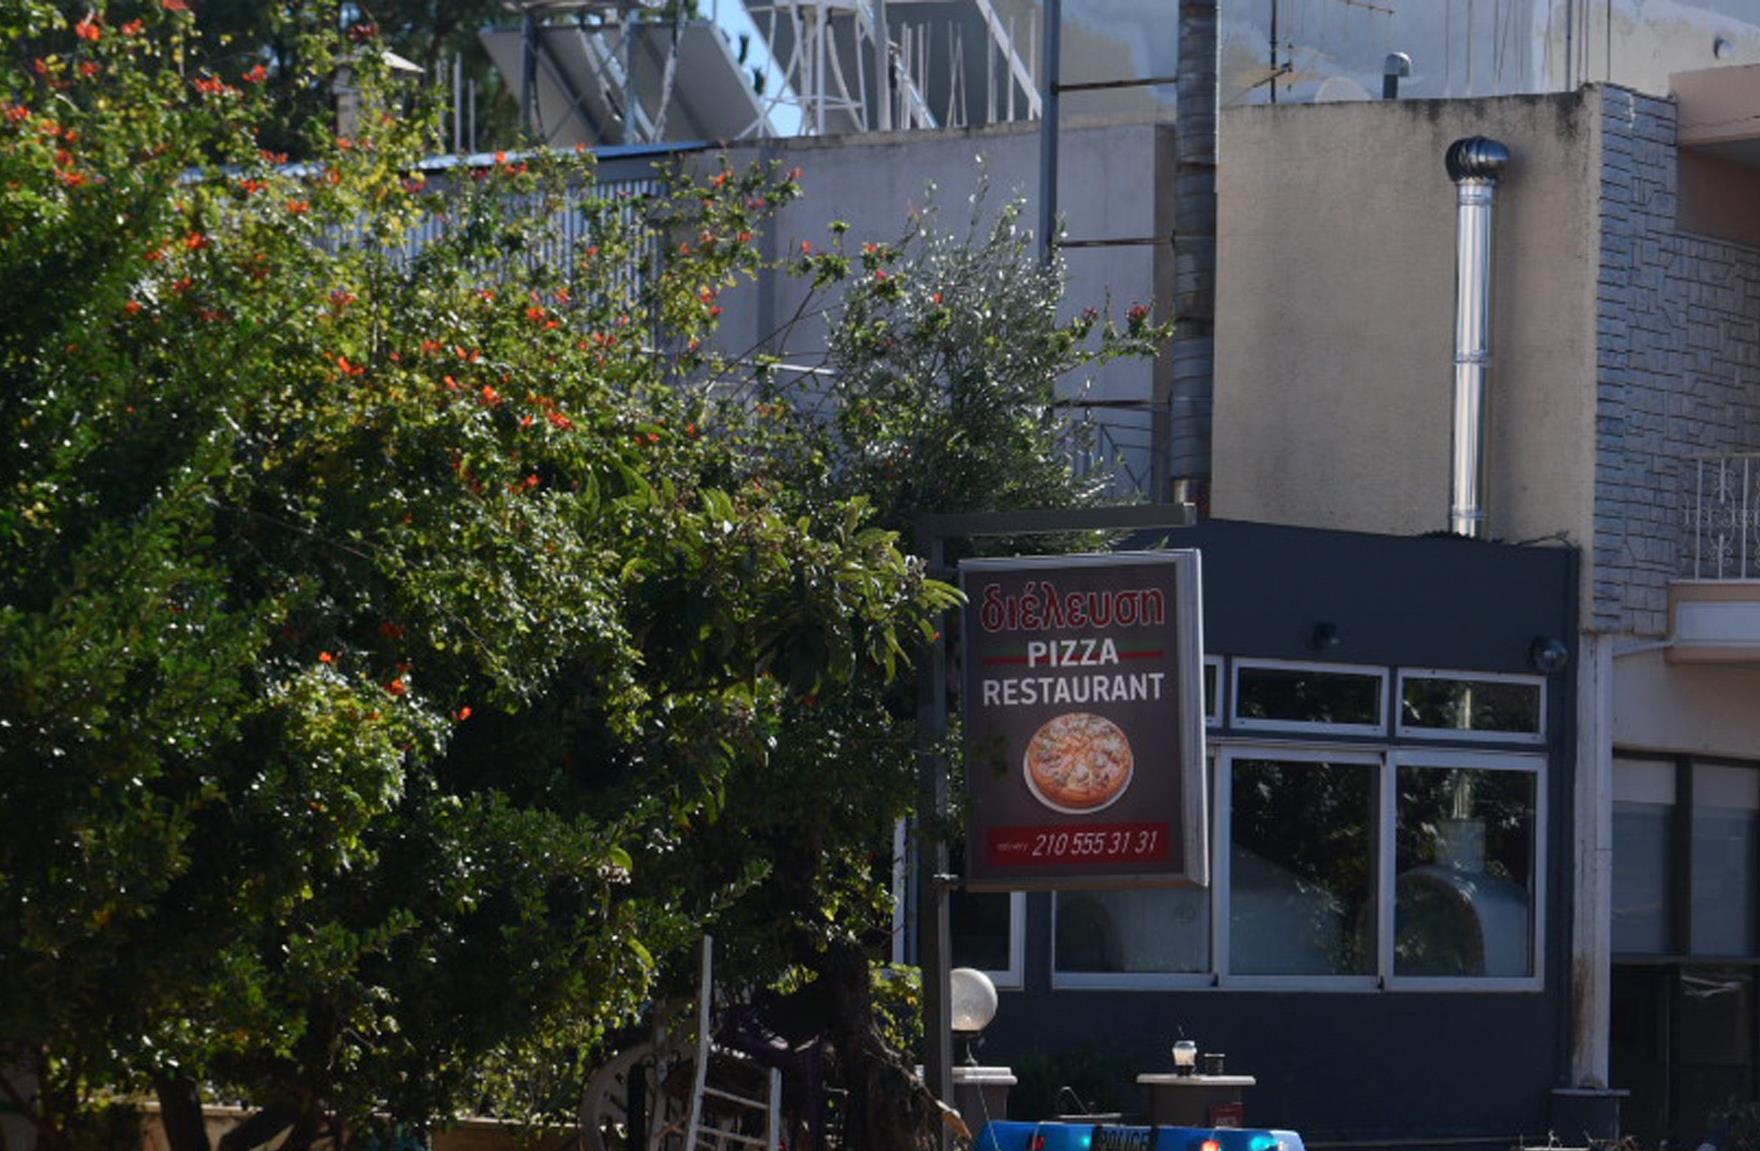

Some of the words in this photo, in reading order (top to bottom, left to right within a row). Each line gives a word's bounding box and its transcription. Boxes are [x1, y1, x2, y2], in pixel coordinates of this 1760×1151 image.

[980, 581, 1165, 633] διέλευση
[1027, 638, 1119, 668] PIZZA
[983, 673, 1165, 706] RESTAURANT
[1032, 833, 1069, 857] 210
[1070, 832, 1106, 854] 555
[1108, 831, 1131, 854] 31
[1135, 830, 1158, 853] 31
